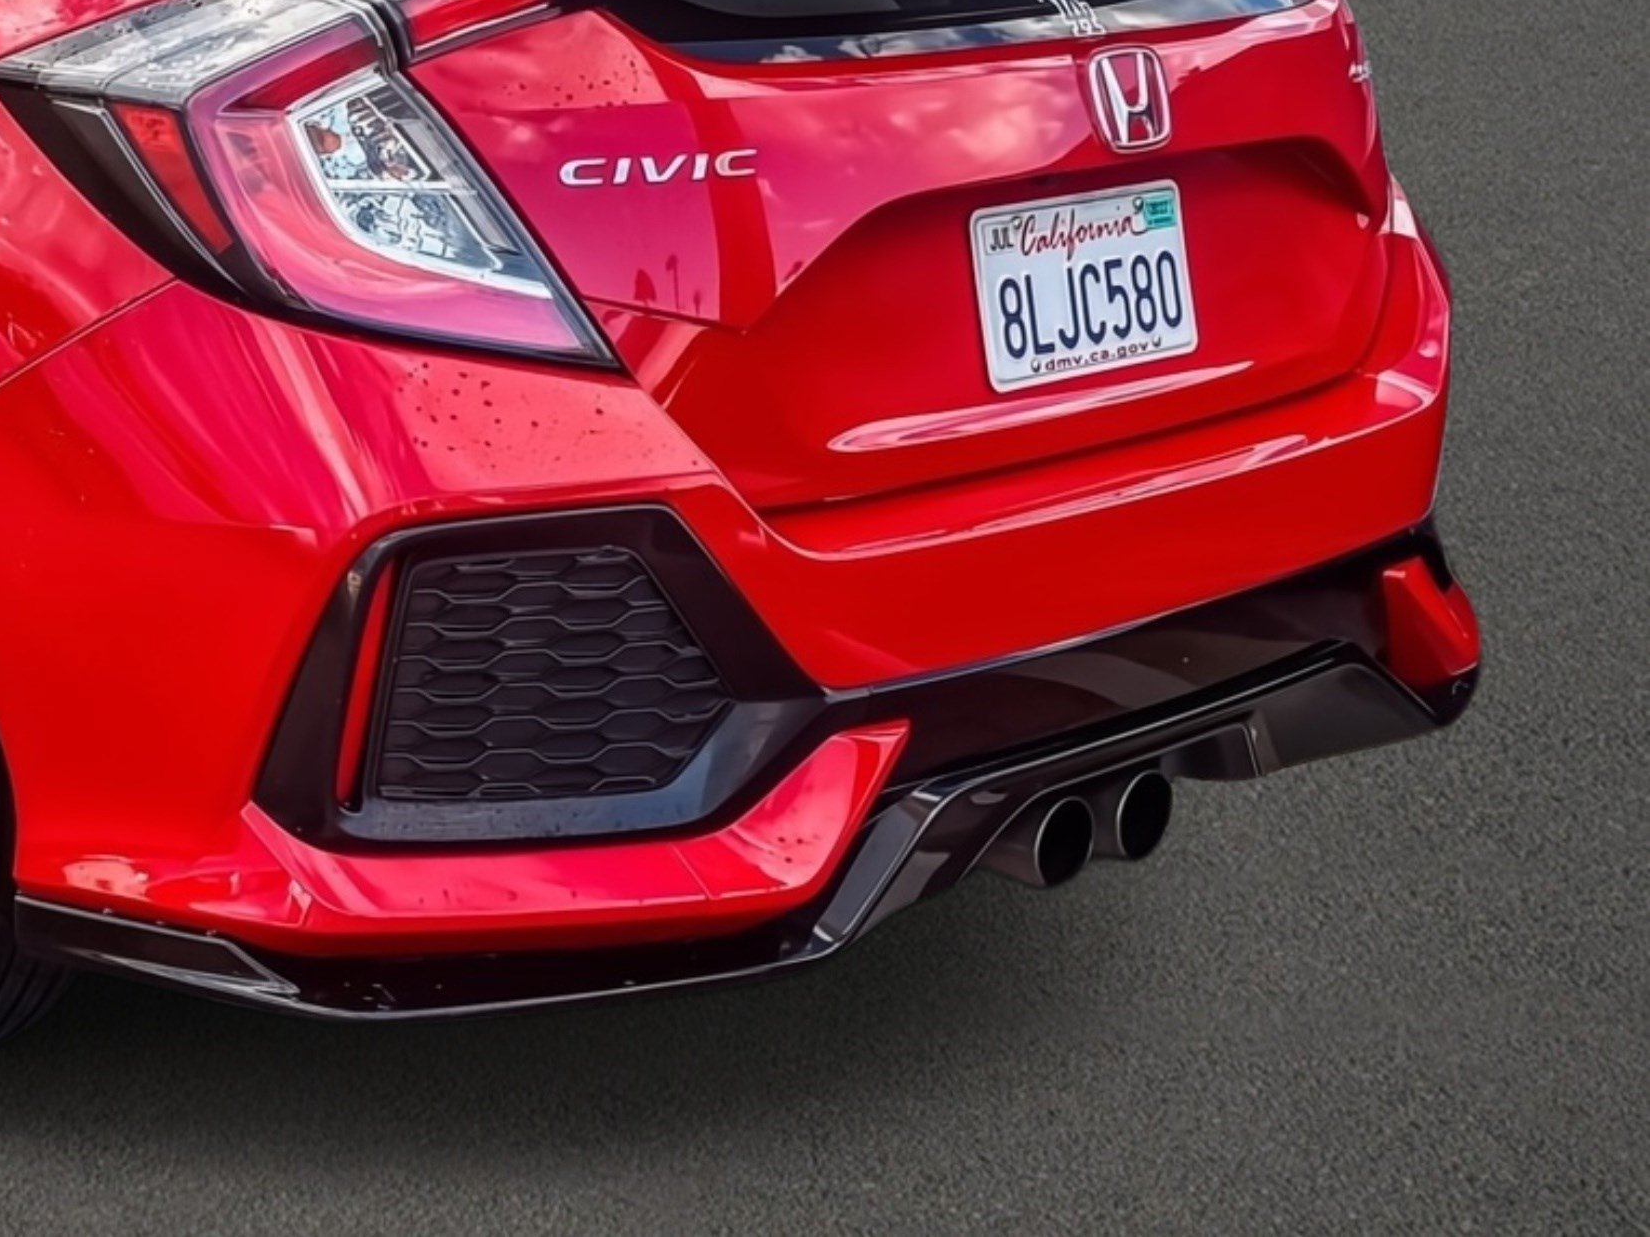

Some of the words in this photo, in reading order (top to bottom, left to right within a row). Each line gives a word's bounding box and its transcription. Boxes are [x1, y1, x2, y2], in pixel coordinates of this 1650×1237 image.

[559, 148, 758, 186] CIVIC
[989, 225, 1014, 252] JUL
[1020, 208, 1148, 262] California
[999, 250, 1183, 360] 8LJC580
[1044, 340, 1149, 372] dmv.ca.gov
